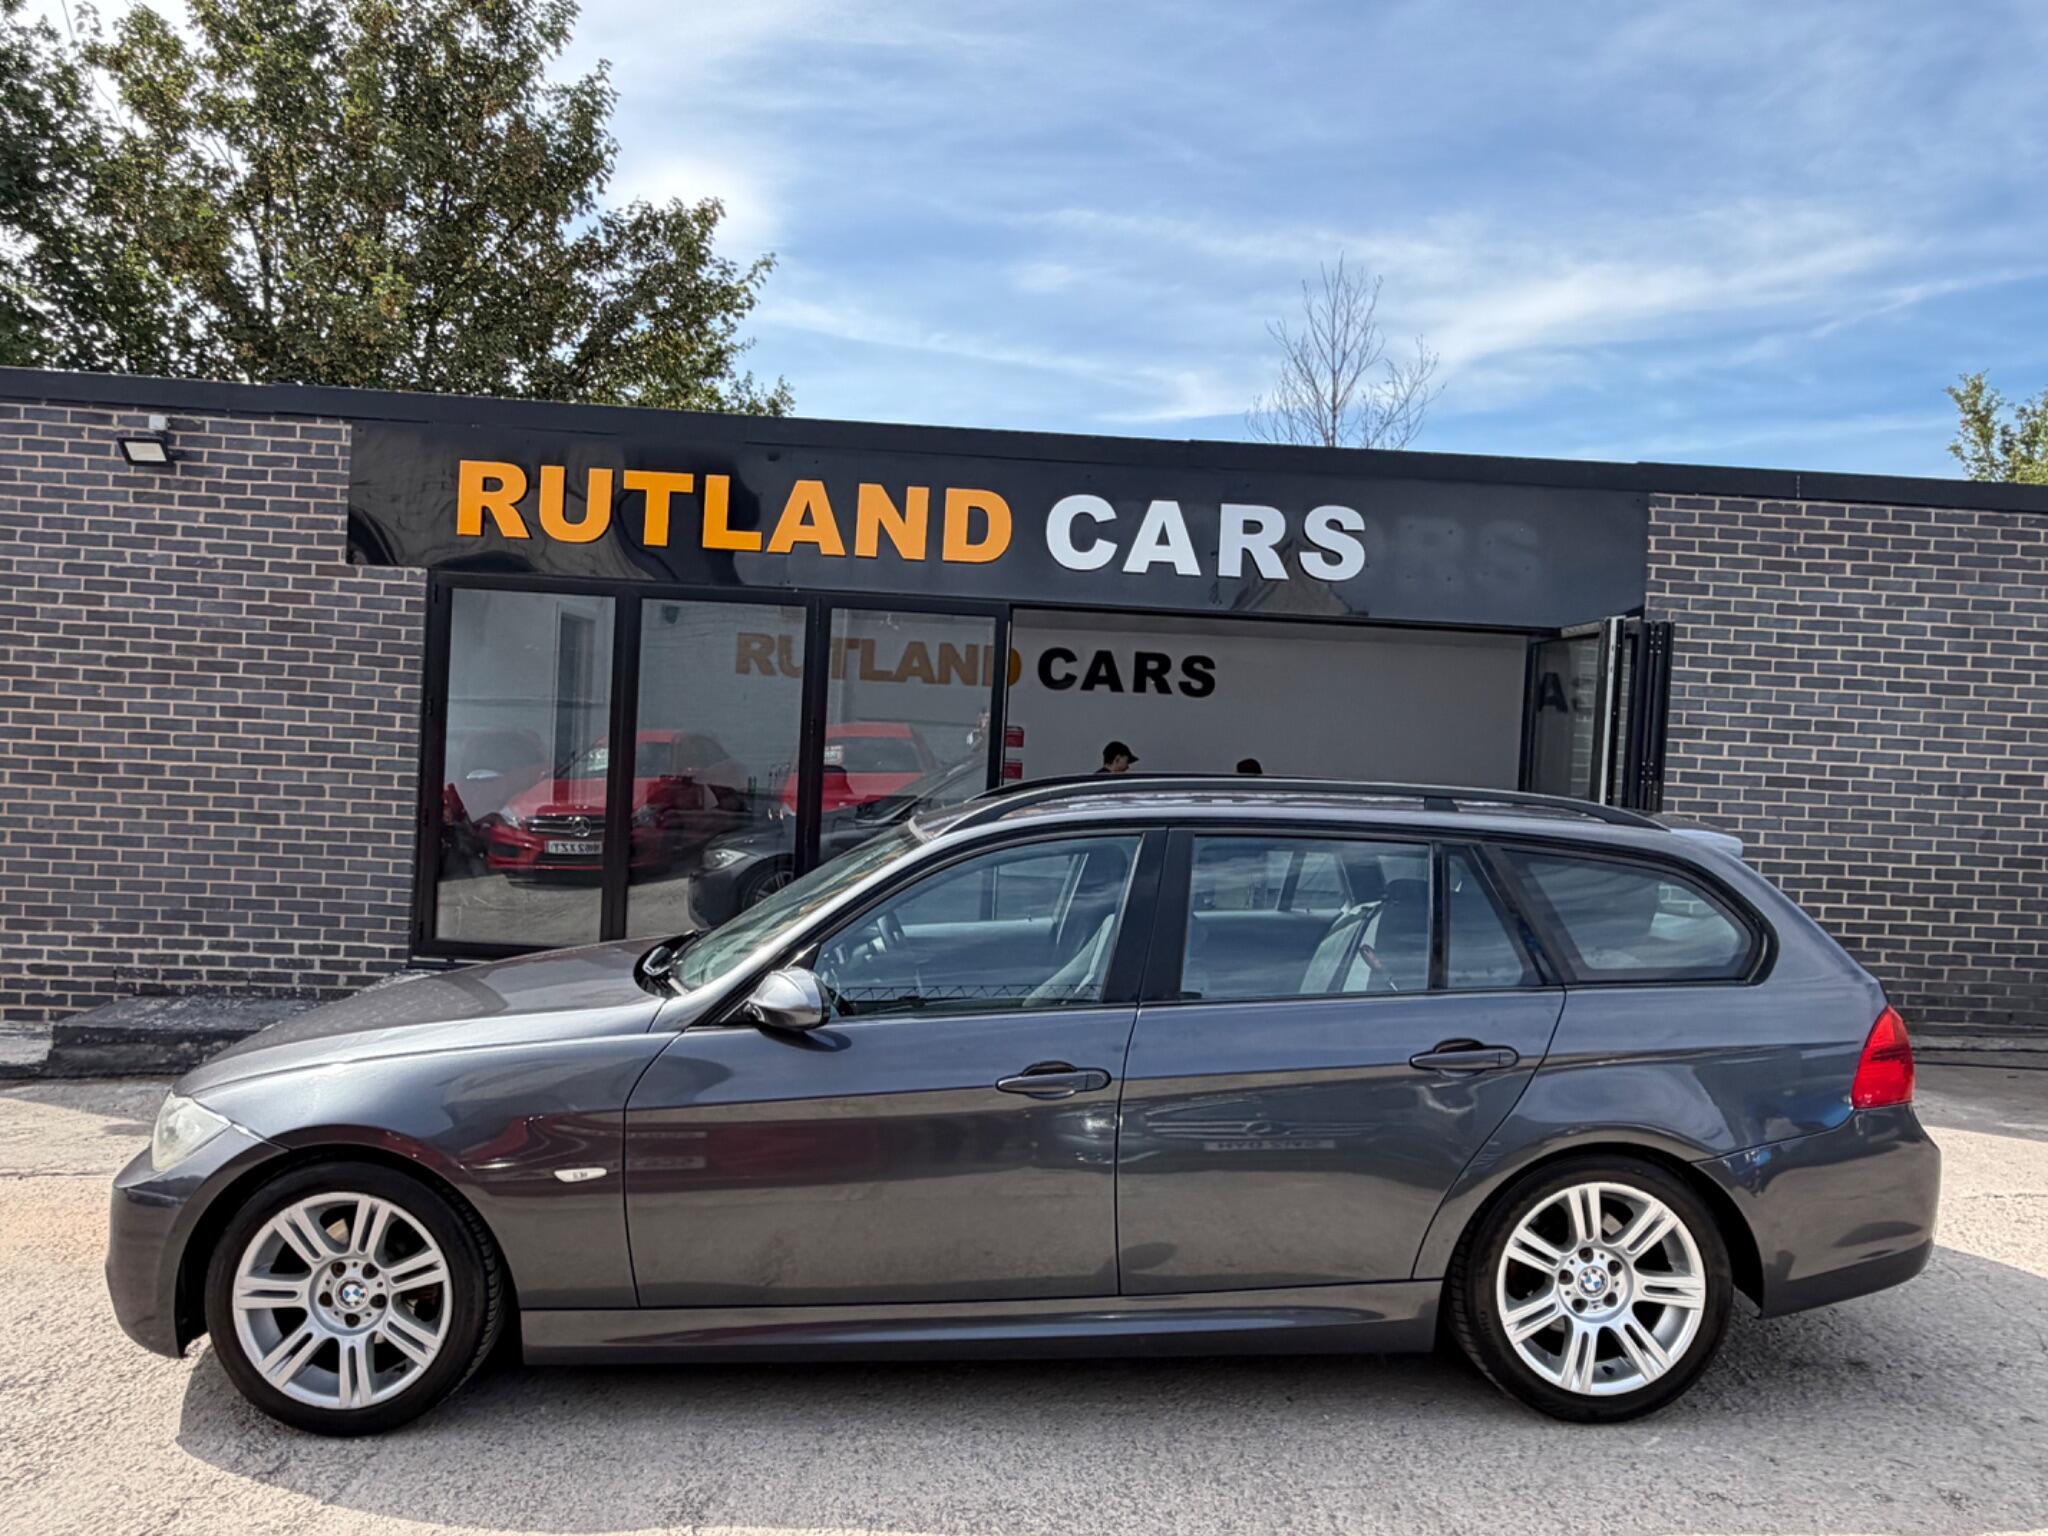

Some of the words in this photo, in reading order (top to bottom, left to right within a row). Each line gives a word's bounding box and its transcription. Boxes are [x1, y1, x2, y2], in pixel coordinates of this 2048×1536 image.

[456, 459, 1013, 563] RUTLAND
[1046, 494, 1365, 581] CARS
[1037, 647, 1217, 698] CARS
